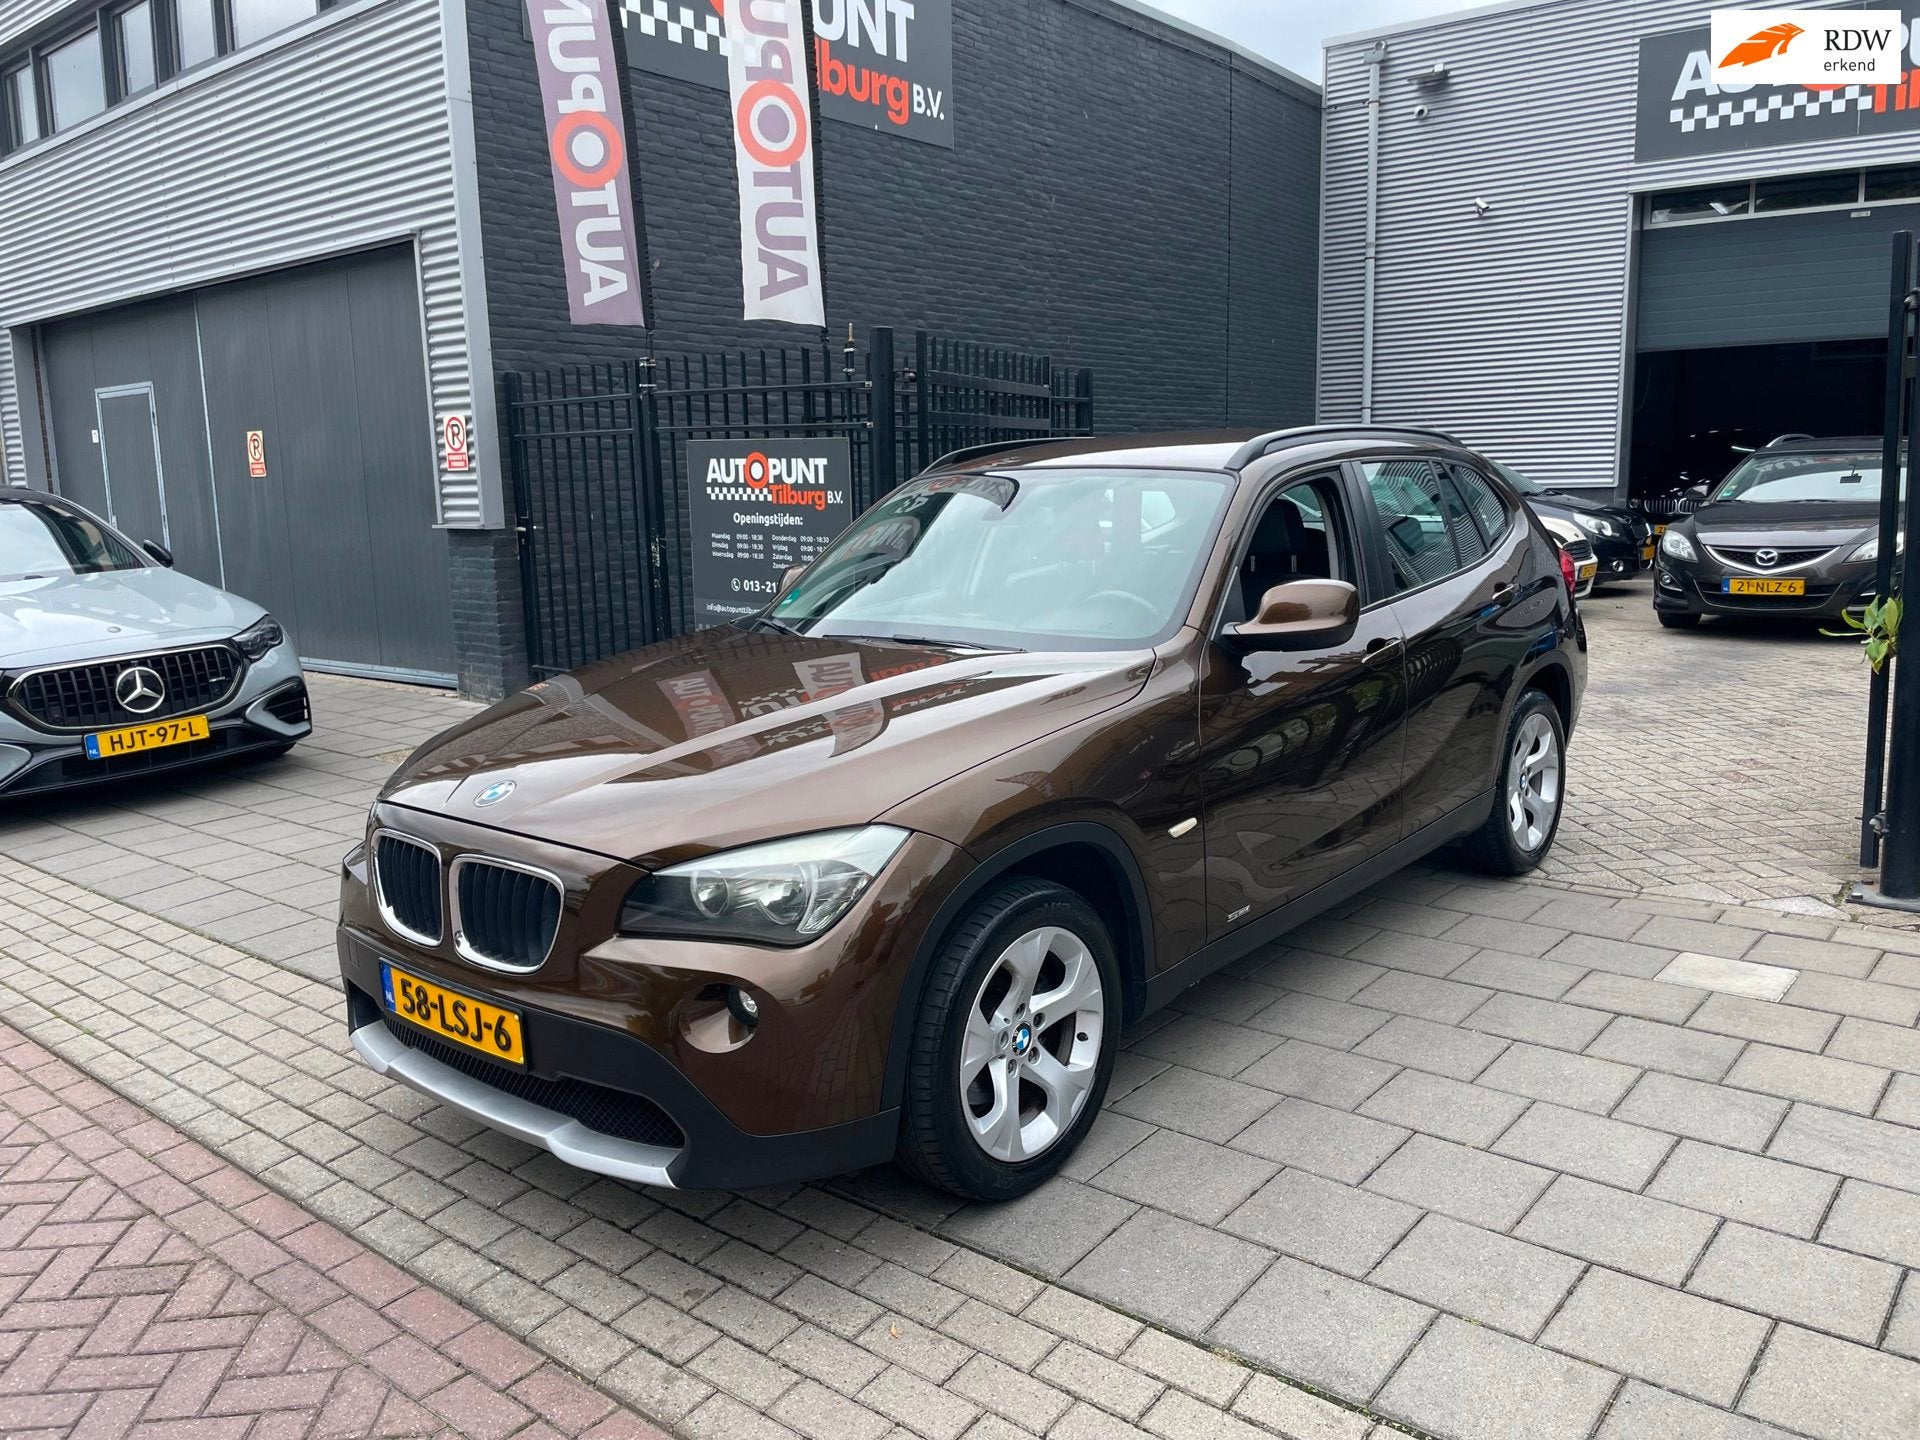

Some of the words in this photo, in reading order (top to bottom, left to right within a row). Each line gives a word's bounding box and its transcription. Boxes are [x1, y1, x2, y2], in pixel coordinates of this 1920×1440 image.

[812, 0, 914, 62] UNT
[913, 83, 945, 121] B.V.
[706, 451, 828, 489] AUTOPUNT
[769, 484, 826, 511] Tilburg
[827, 490, 844, 504] B.V.
[733, 512, 804, 527] Openingstijden:
[771, 534, 797, 543] Donderdag
[743, 579, 778, 593] 013-21
[1736, 581, 1797, 593] 21-NLZ-6
[109, 721, 200, 752] HJT-97-L
[400, 977, 512, 1052] 58-LSJ-6
